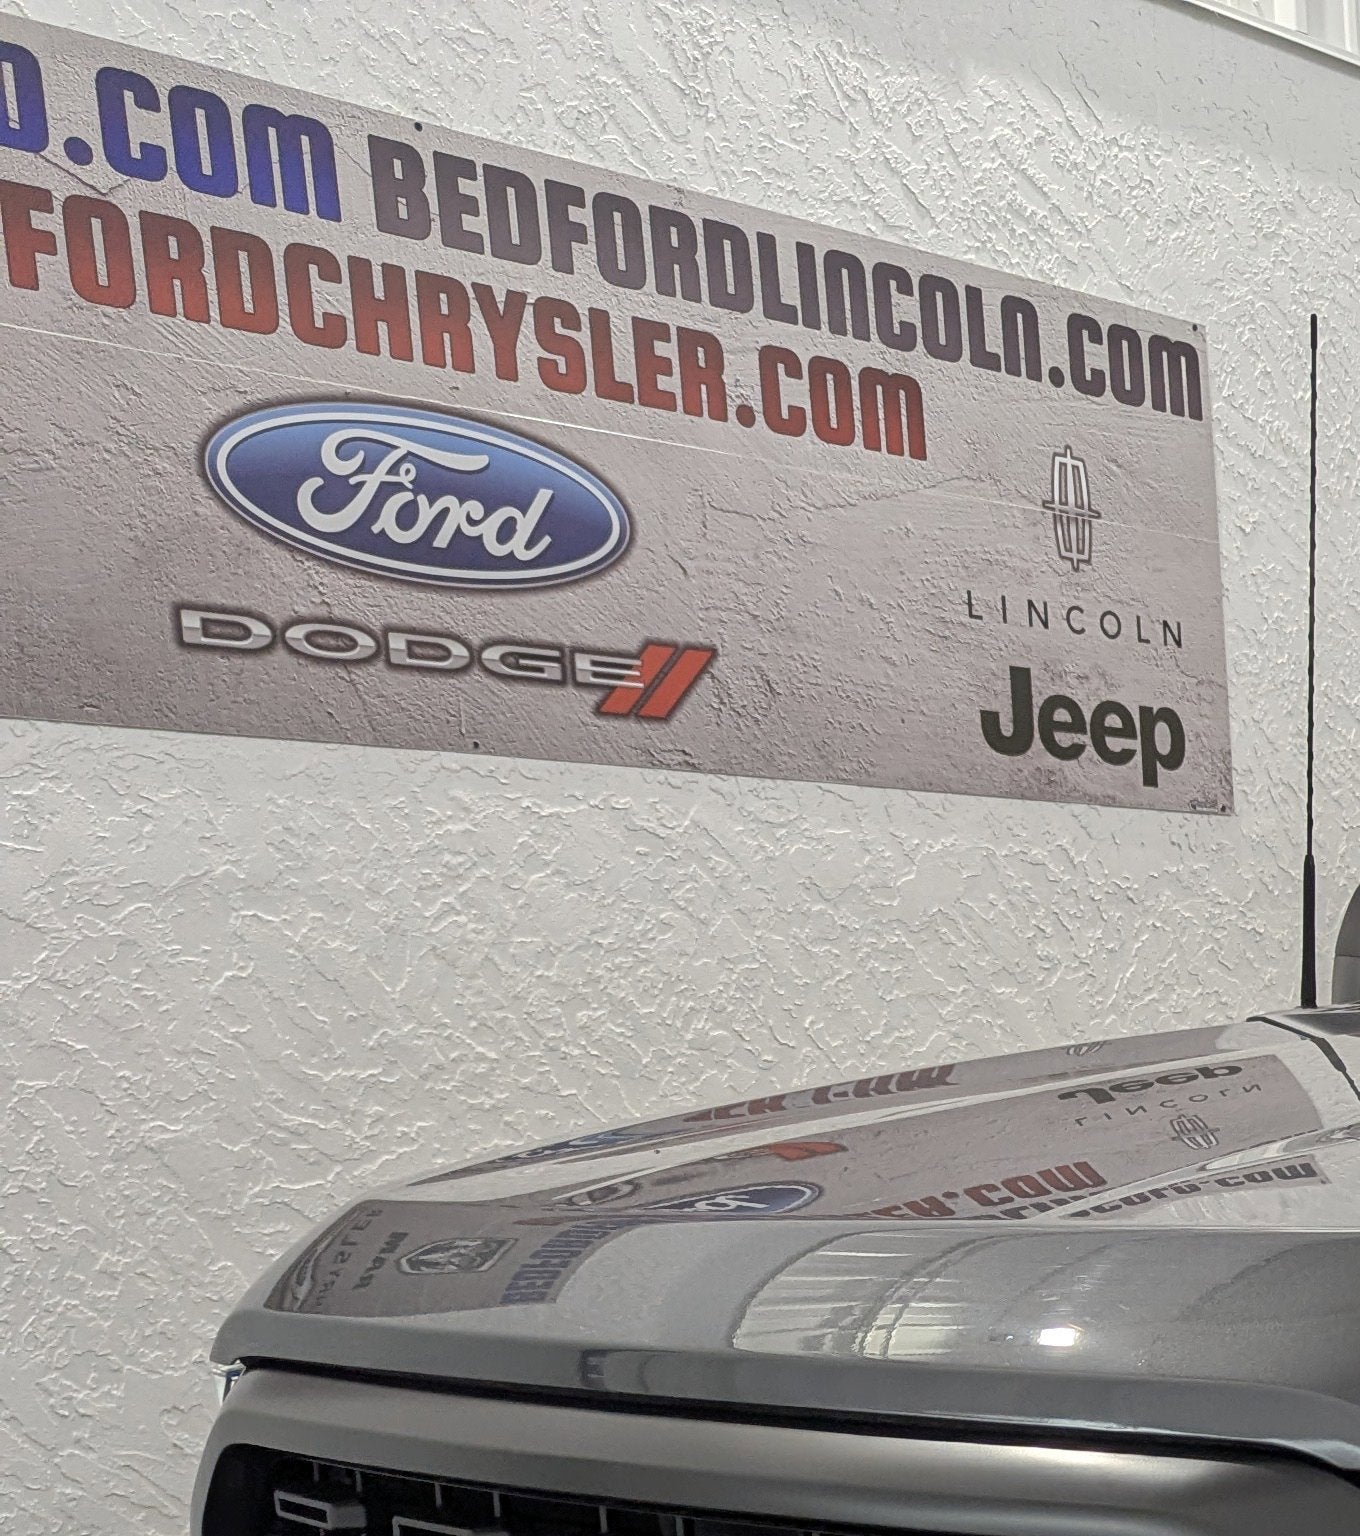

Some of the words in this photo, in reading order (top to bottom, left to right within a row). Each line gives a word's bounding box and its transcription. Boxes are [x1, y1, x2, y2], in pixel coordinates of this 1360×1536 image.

[367, 134, 1203, 422] BEDFORDLINCOLN.COM
[296, 427, 553, 562] Ford
[179, 608, 645, 691] DODGE
[966, 589, 1183, 649] LINCOLN
[979, 664, 1186, 788] Jeep
